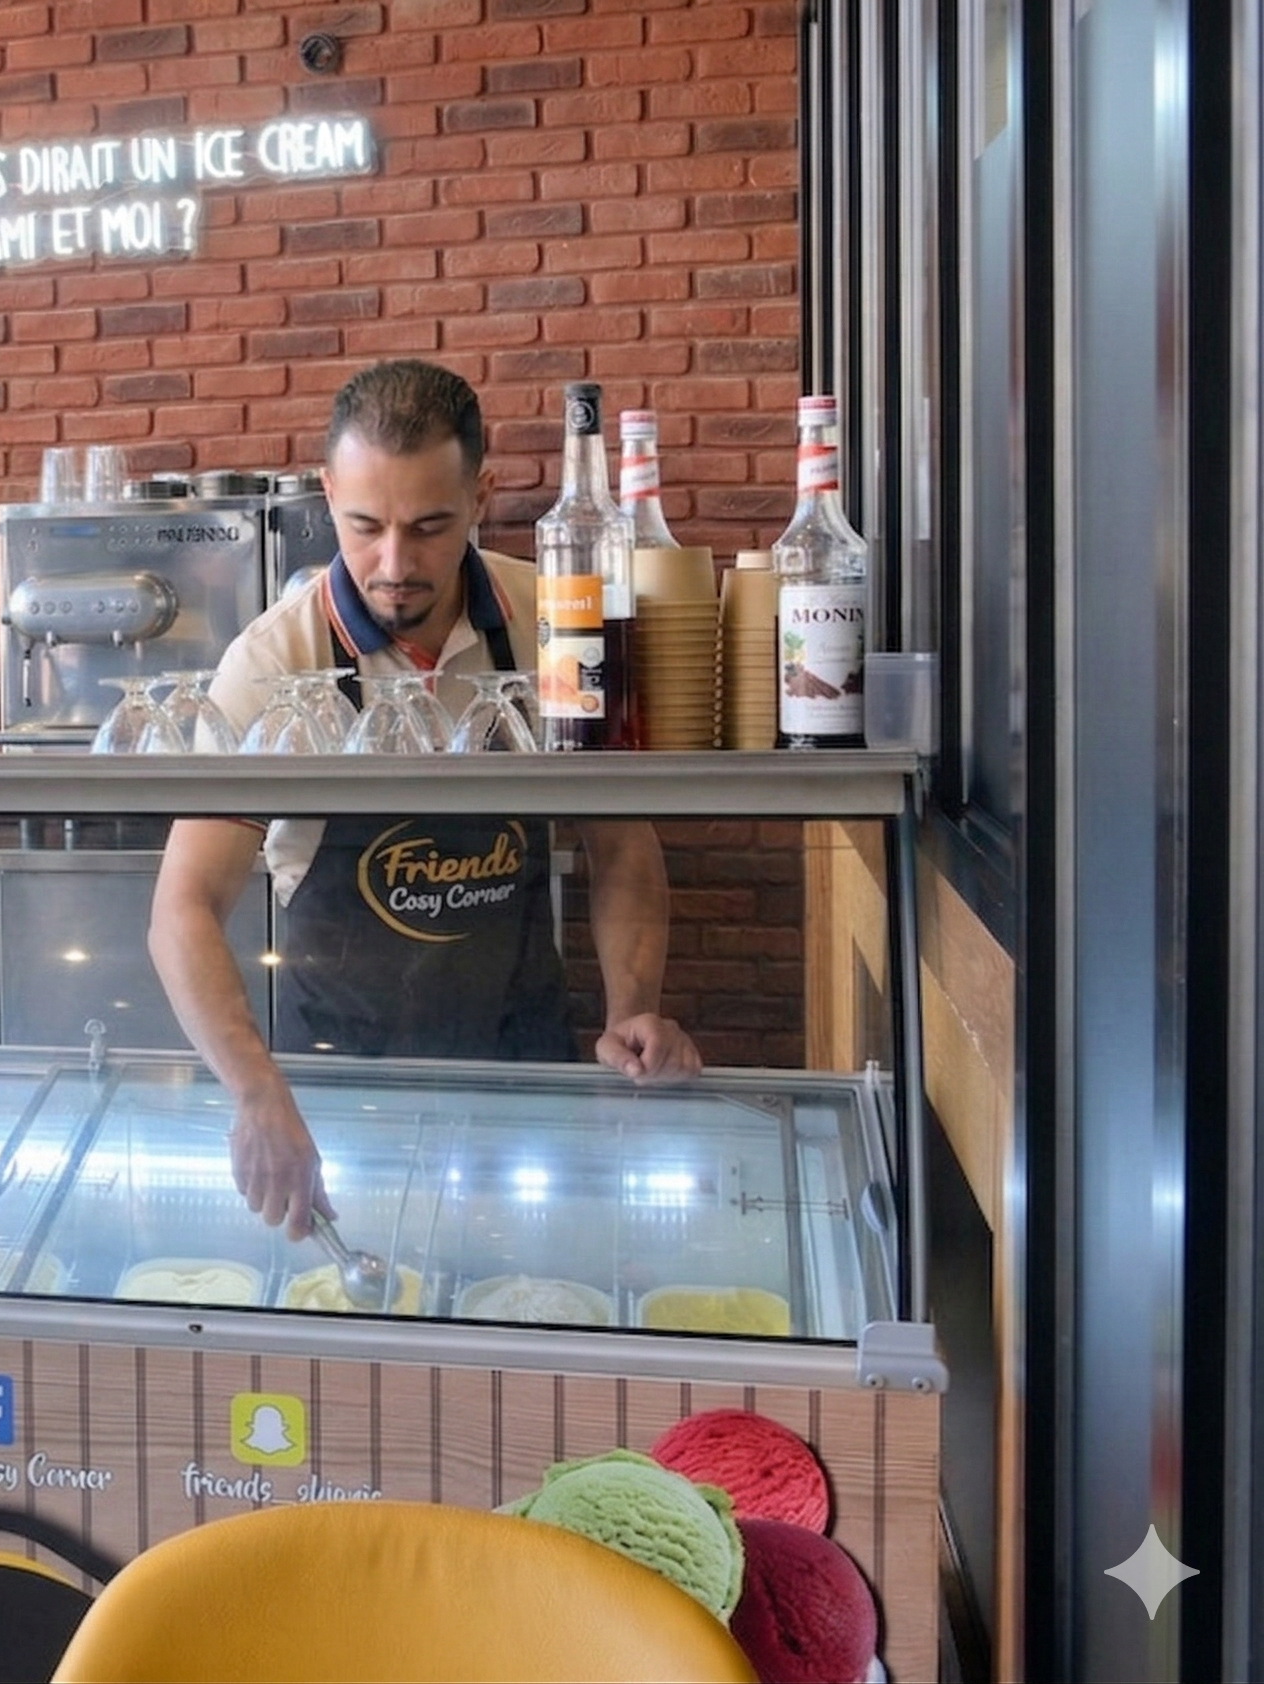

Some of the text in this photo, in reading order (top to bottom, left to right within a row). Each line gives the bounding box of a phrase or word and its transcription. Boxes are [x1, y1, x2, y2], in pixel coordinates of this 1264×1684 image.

[19, 140, 121, 196] DIRAIT
[130, 136, 178, 183] UN
[194, 129, 246, 181] ICE
[257, 120, 367, 174] CREAM
[51, 206, 91, 255] ET
[101, 201, 162, 256] MOI
[175, 197, 197, 252] ?
[375, 831, 522, 888] Friends
[388, 883, 516, 919] Cosy Corner
[26, 1452, 113, 1490] Corner
